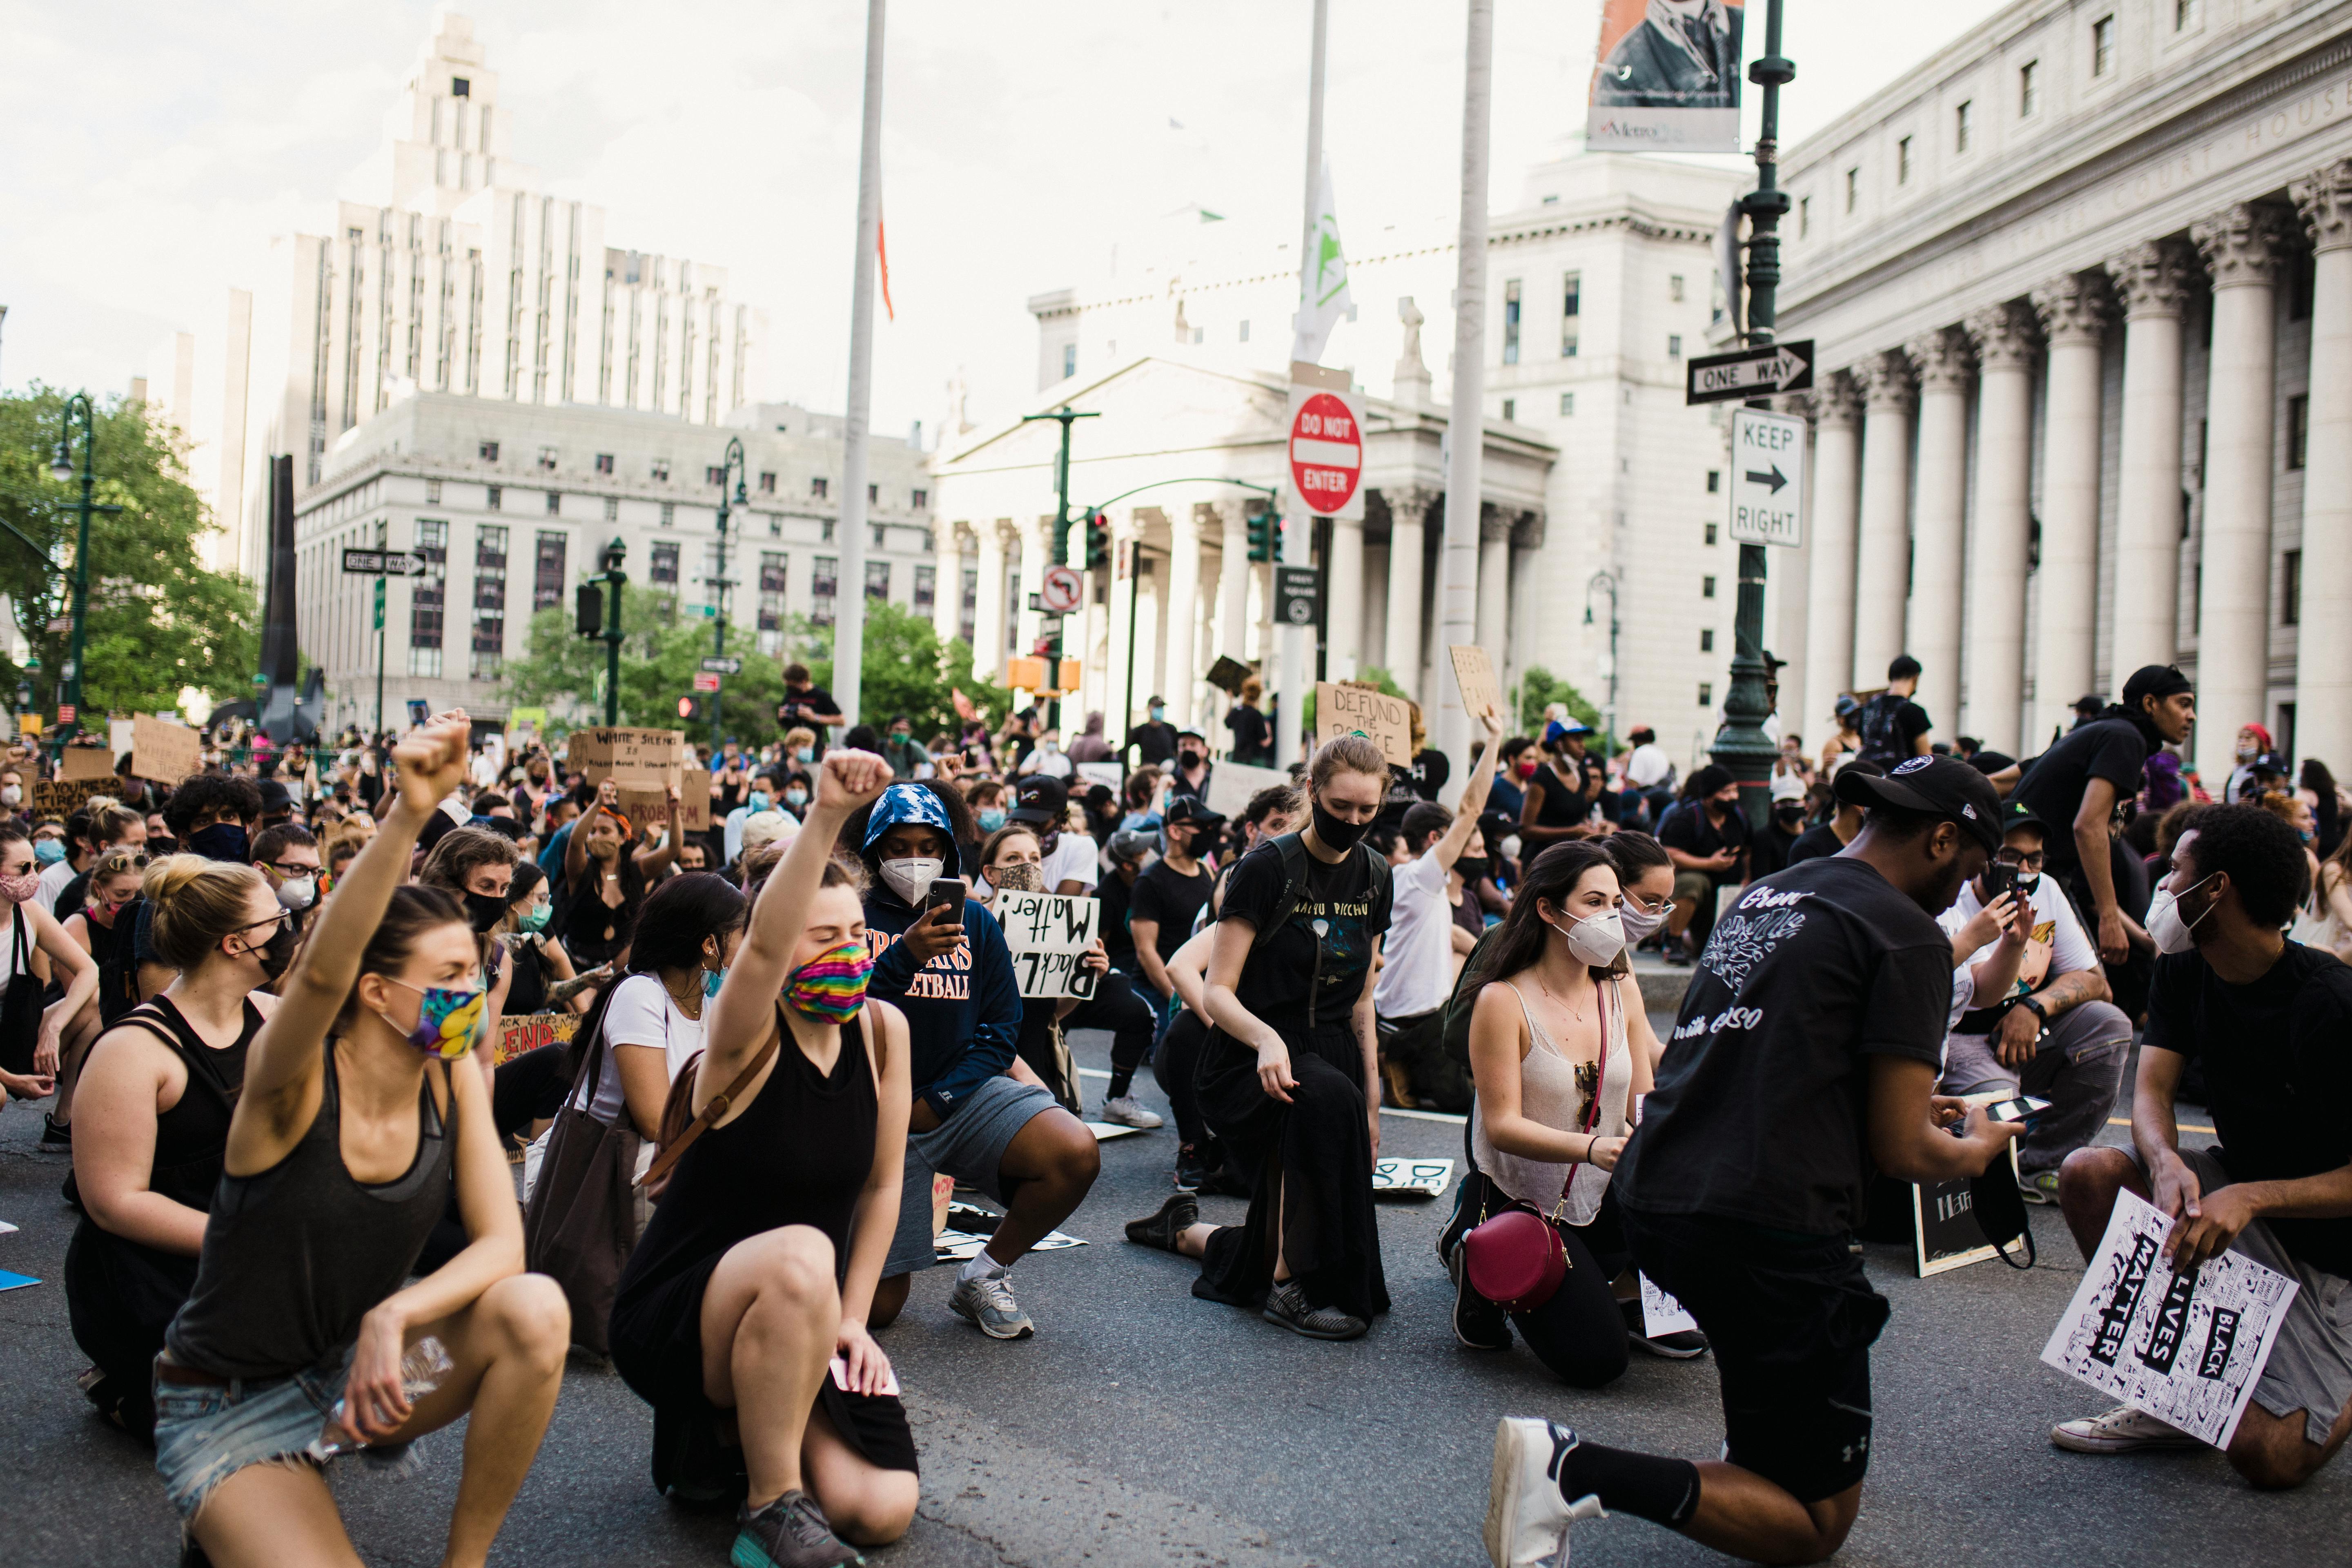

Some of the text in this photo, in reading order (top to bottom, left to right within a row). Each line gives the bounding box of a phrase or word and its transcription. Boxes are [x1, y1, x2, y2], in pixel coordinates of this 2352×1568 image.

[1704, 357, 1795, 388] ONE WAY
[1301, 413, 1352, 438] DO NOT
[1744, 421, 1793, 451] KEEP
[1303, 468, 1348, 492] ENTER
[1737, 506, 1794, 535] RIGHT
[350, 556, 413, 568] ONE WAY
[1335, 690, 1401, 725] DEFUND
[1354, 715, 1377, 730] THE
[595, 731, 634, 745] WHITE
[1739, 886, 1815, 909] Grow
[1334, 902, 1368, 916] PICCHU
[528, 1016, 557, 1026] LIVES
[504, 1023, 554, 1053] END
[2201, 1274, 2214, 1296] ARBERY
[2205, 1276, 2217, 1297] AHMAUD
[2256, 1279, 2265, 1296] RICE
[2262, 1281, 2273, 1300] TAMIR
[2098, 1239, 2154, 1358] MATTER
[2224, 1288, 2233, 1305] REED
[2230, 1292, 2238, 1307] SEAN
[2150, 1276, 2190, 1361] LIVES
[2251, 1305, 2263, 1330] TAYLOR
[2256, 1309, 2267, 1333] BREONNA
[2205, 1313, 2234, 1375] BLACK
[2237, 1368, 2247, 1383] DAVID
[2120, 1377, 2132, 1397] BROWN
[2124, 1379, 2136, 1399] MICHAEL
[2147, 1379, 2160, 1402] LAQUAN
[2216, 1388, 2226, 1409] GARNER
[2223, 1392, 2231, 1407] ERIC
[2203, 1411, 2216, 1430] FLOYD
[2208, 1414, 2221, 1436] GEORGE
